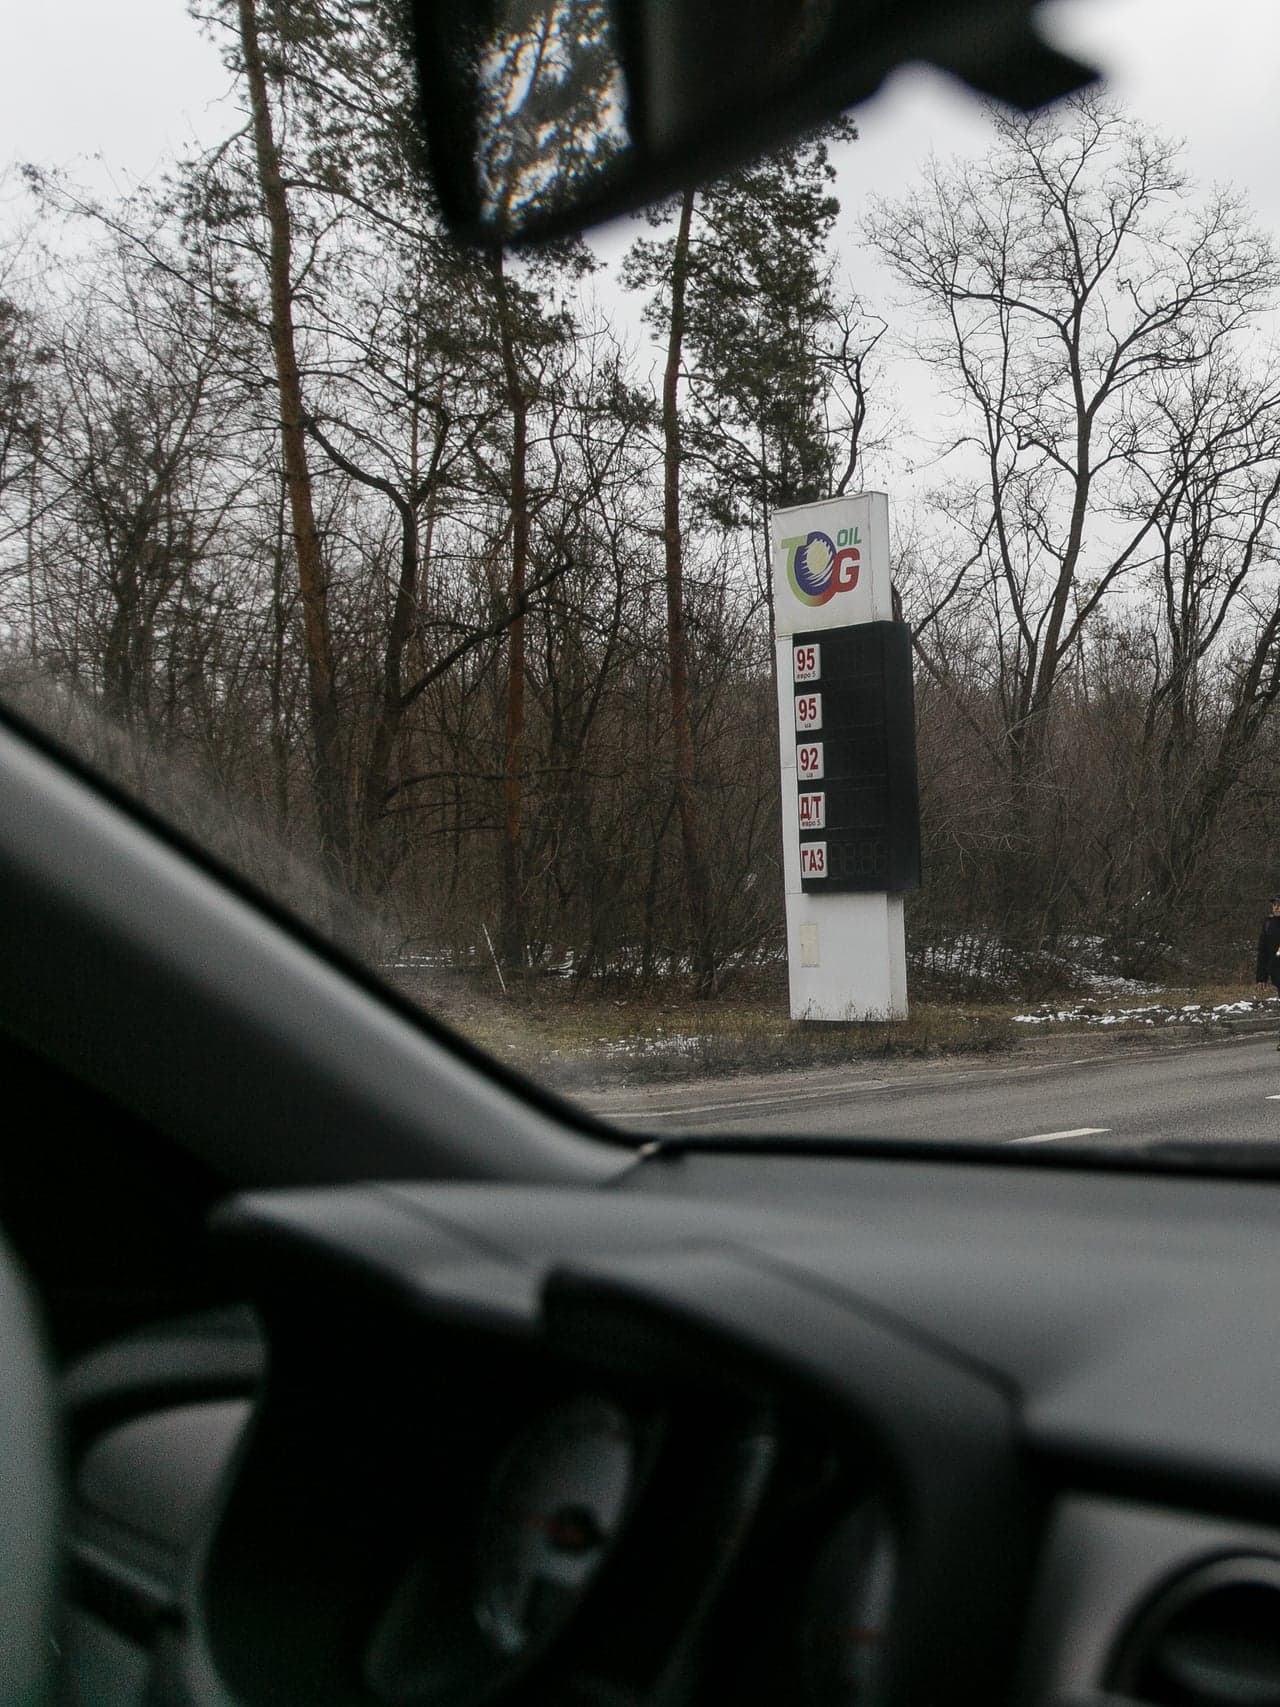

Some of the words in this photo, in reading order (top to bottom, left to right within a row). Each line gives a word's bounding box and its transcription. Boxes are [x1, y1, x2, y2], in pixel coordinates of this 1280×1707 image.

[837, 527, 862, 547] OIL
[797, 647, 815, 671] 95
[799, 697, 817, 721] 95
[801, 747, 819, 771] 92
[802, 848, 824, 872] ГАЗ
